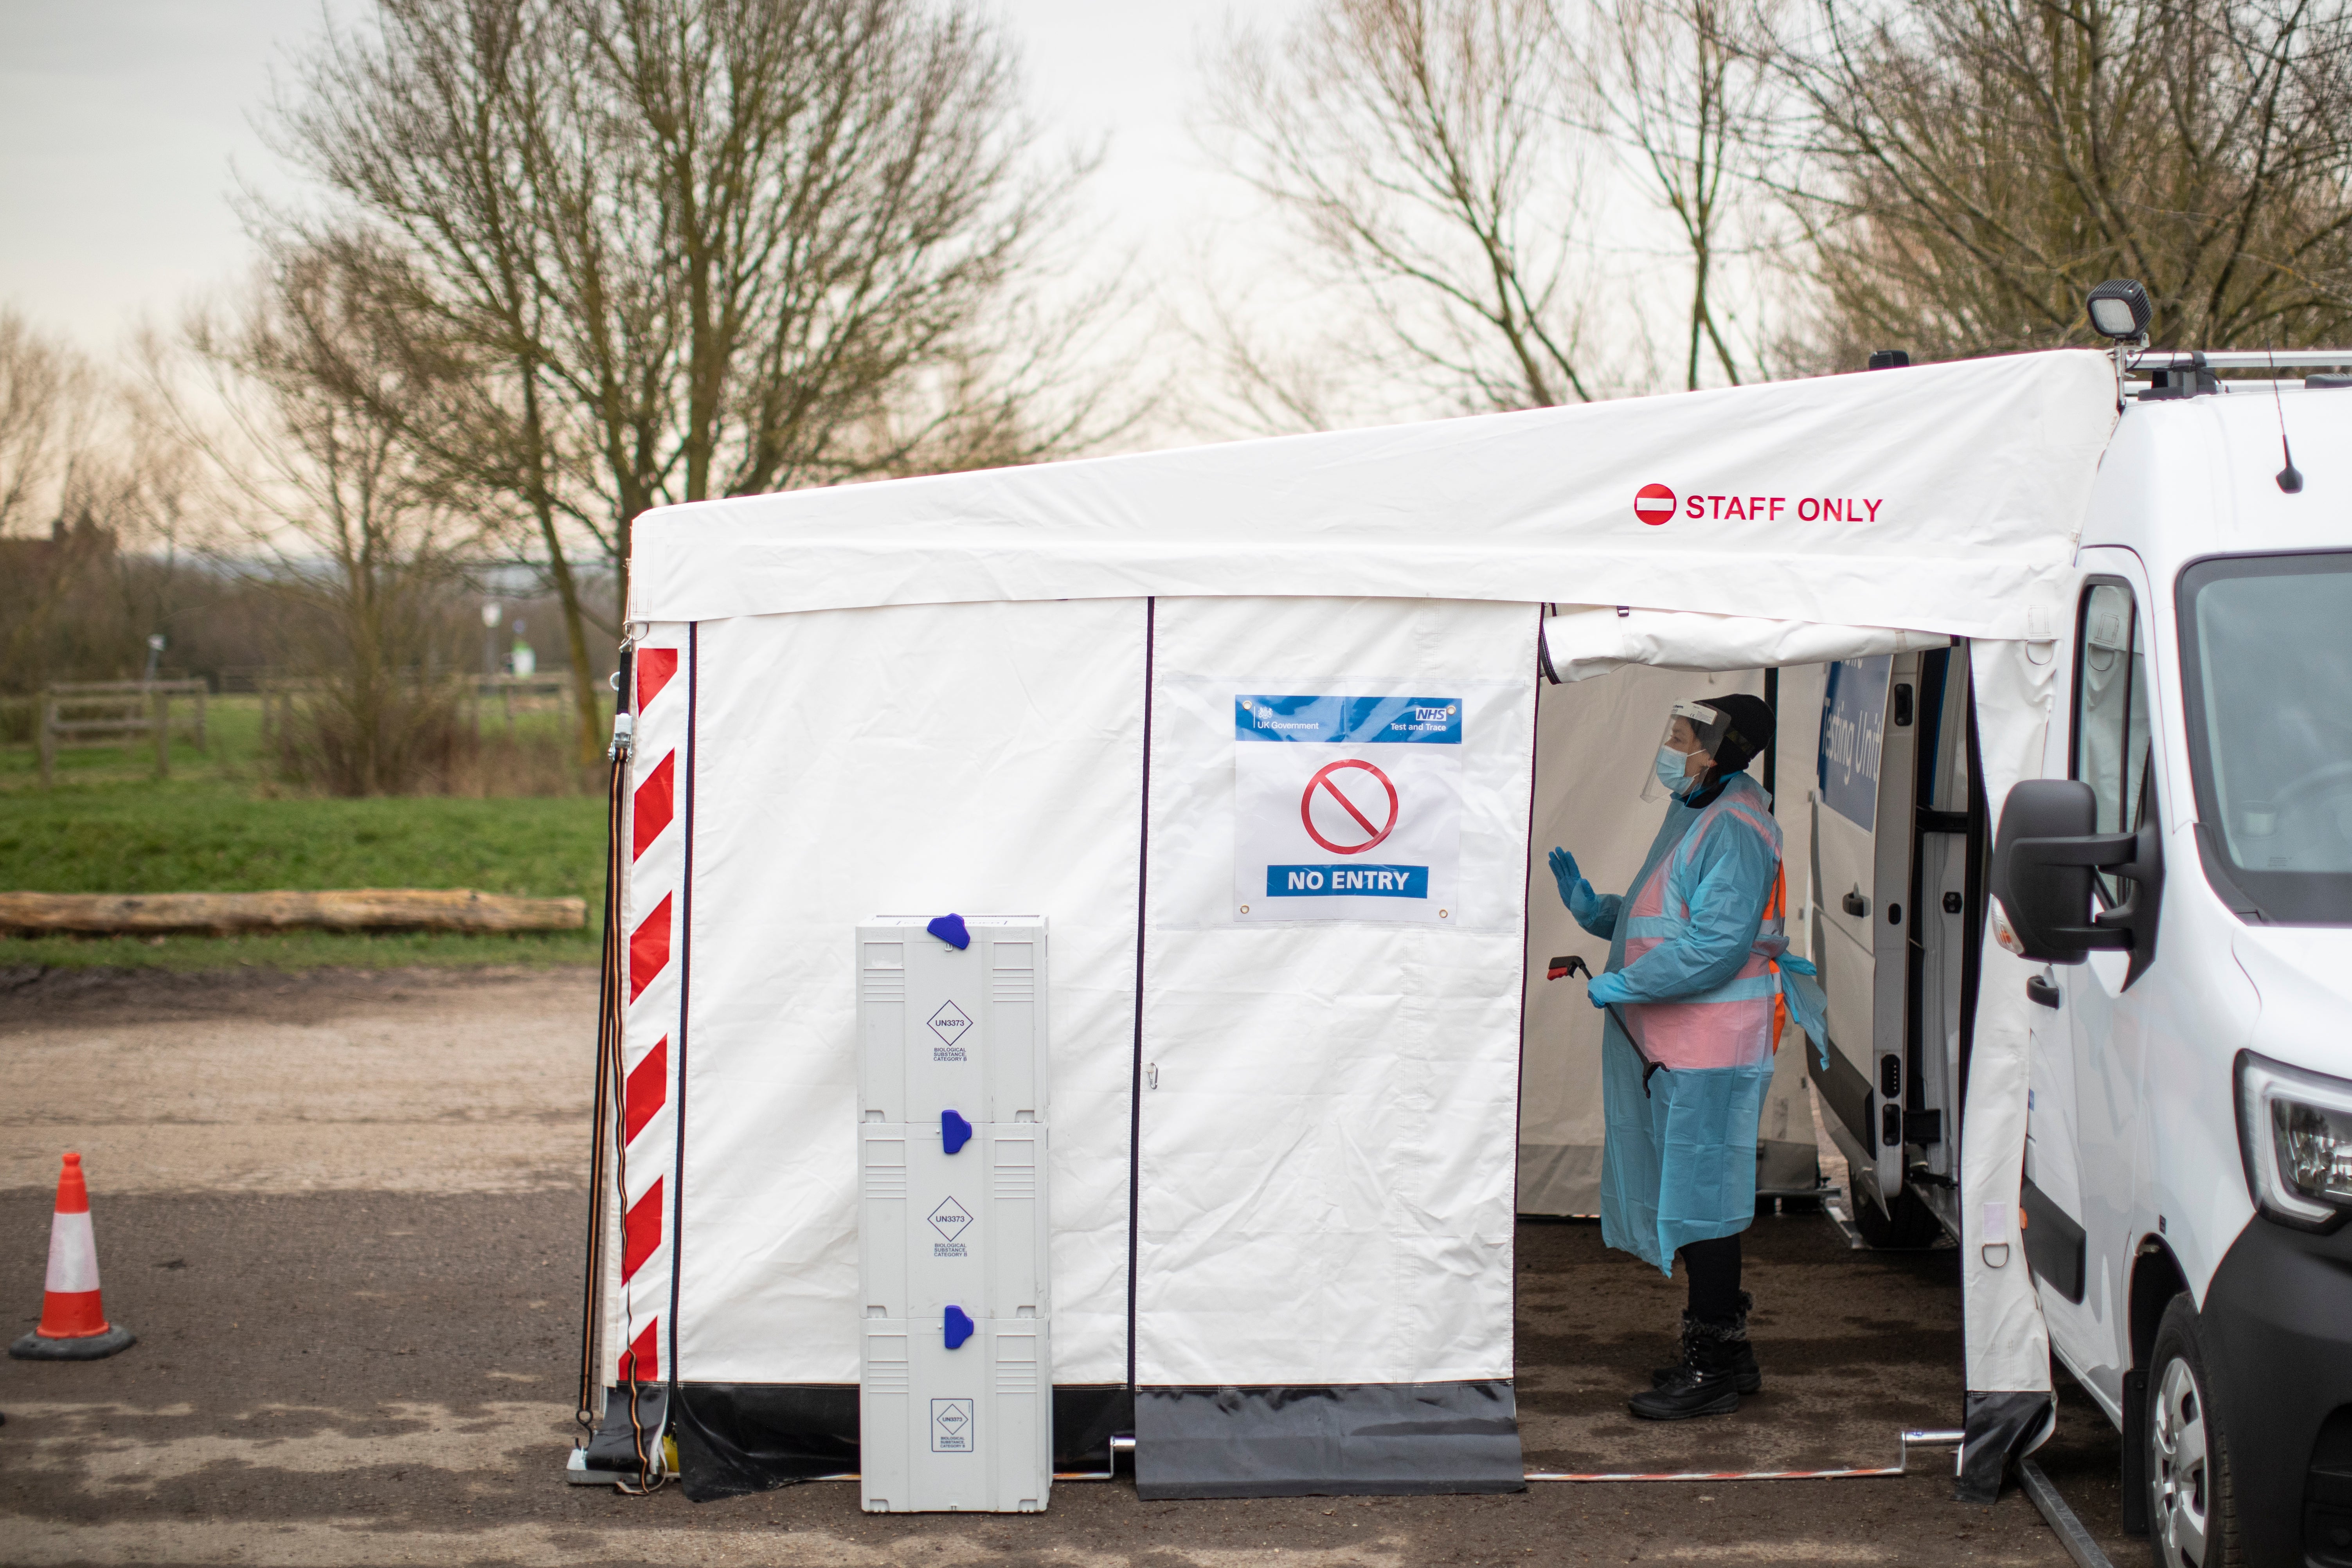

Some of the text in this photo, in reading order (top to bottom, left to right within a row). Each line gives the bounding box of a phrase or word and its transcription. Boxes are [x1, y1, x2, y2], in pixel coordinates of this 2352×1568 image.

[1686, 495, 1883, 522] STAFF ONLY
[1417, 709, 1445, 720] NHS
[1822, 697, 1881, 785] Testing Unit
[1288, 871, 1410, 890] NO ENTRY
